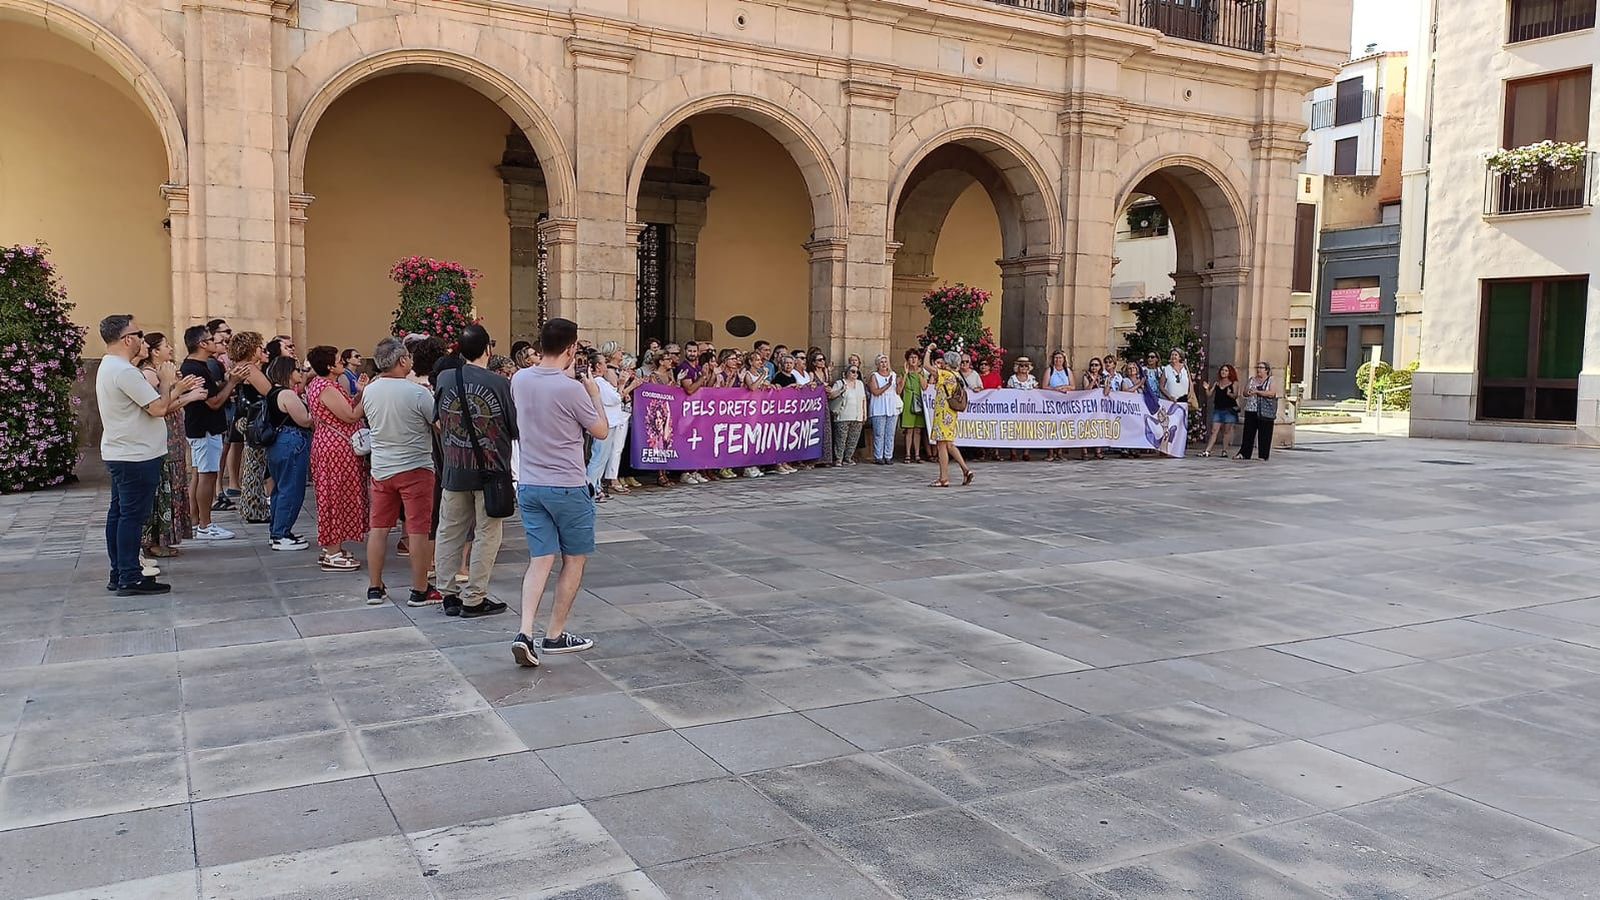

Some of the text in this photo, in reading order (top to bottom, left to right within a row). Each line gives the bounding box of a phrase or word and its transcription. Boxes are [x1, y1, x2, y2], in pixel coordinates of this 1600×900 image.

[682, 397, 822, 417] PELS DRETS DE LES DONES
[966, 398, 1009, 414] transforma
[1010, 399, 1018, 414] el
[1056, 400, 1081, 415] DONES
[1082, 399, 1098, 414] FEM
[686, 418, 820, 457] + FEMINISME
[956, 419, 997, 440] VIMENT
[1000, 419, 1058, 440] FEMINISTA
[1060, 420, 1076, 440] DE
[642, 447, 679, 458] FEMINISTA
